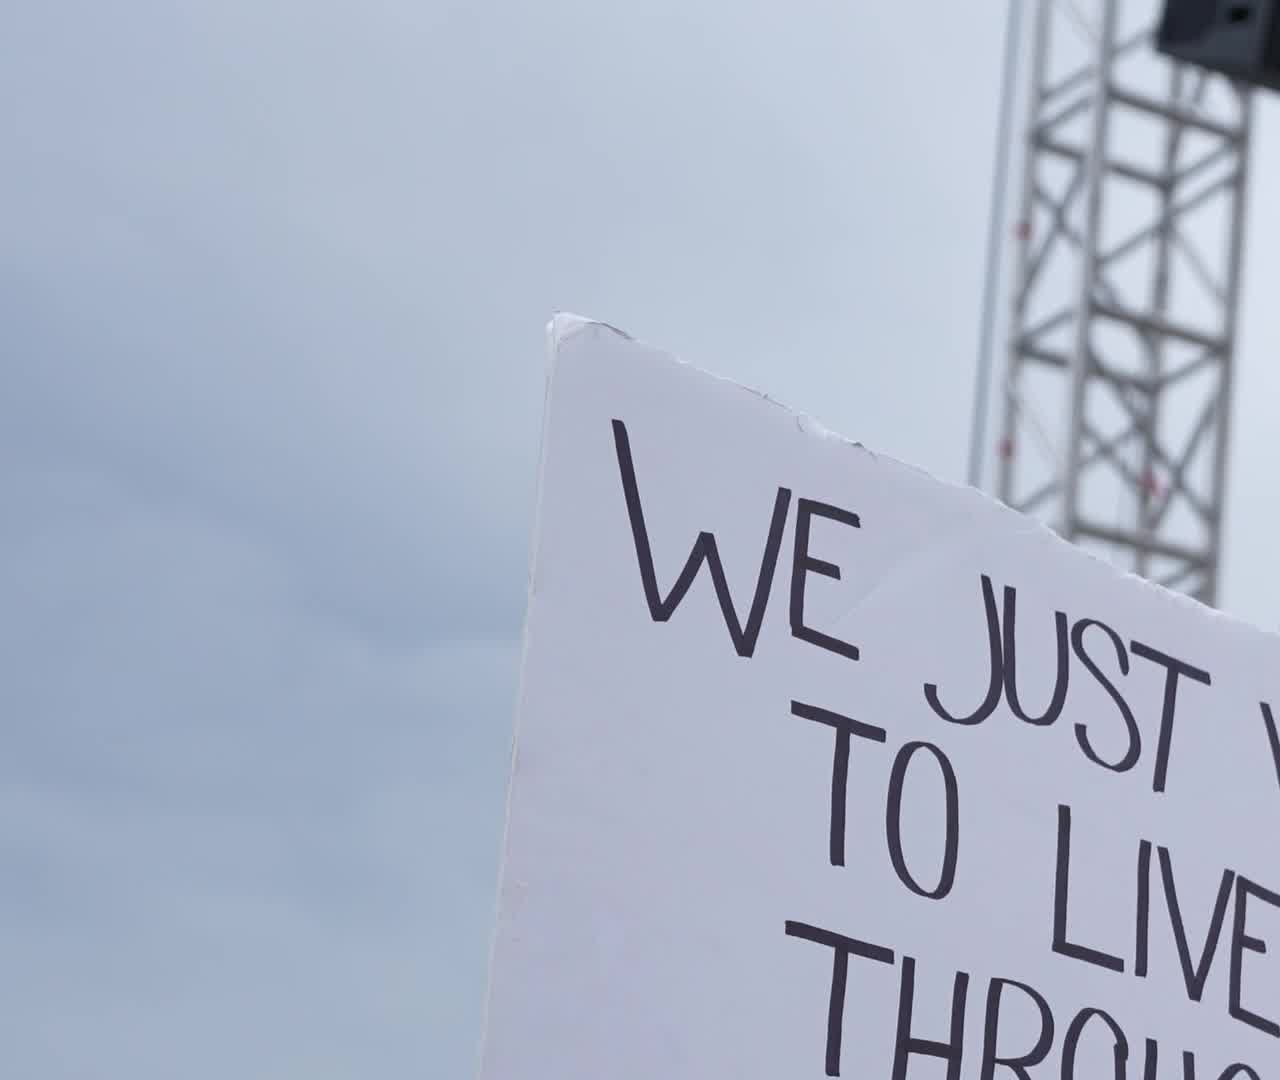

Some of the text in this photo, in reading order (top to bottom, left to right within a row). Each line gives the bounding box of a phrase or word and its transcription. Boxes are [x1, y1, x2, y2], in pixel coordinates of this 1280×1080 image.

[611, 418, 861, 662] WE
[923, 574, 1213, 794] JUST
[790, 699, 960, 902] TO
